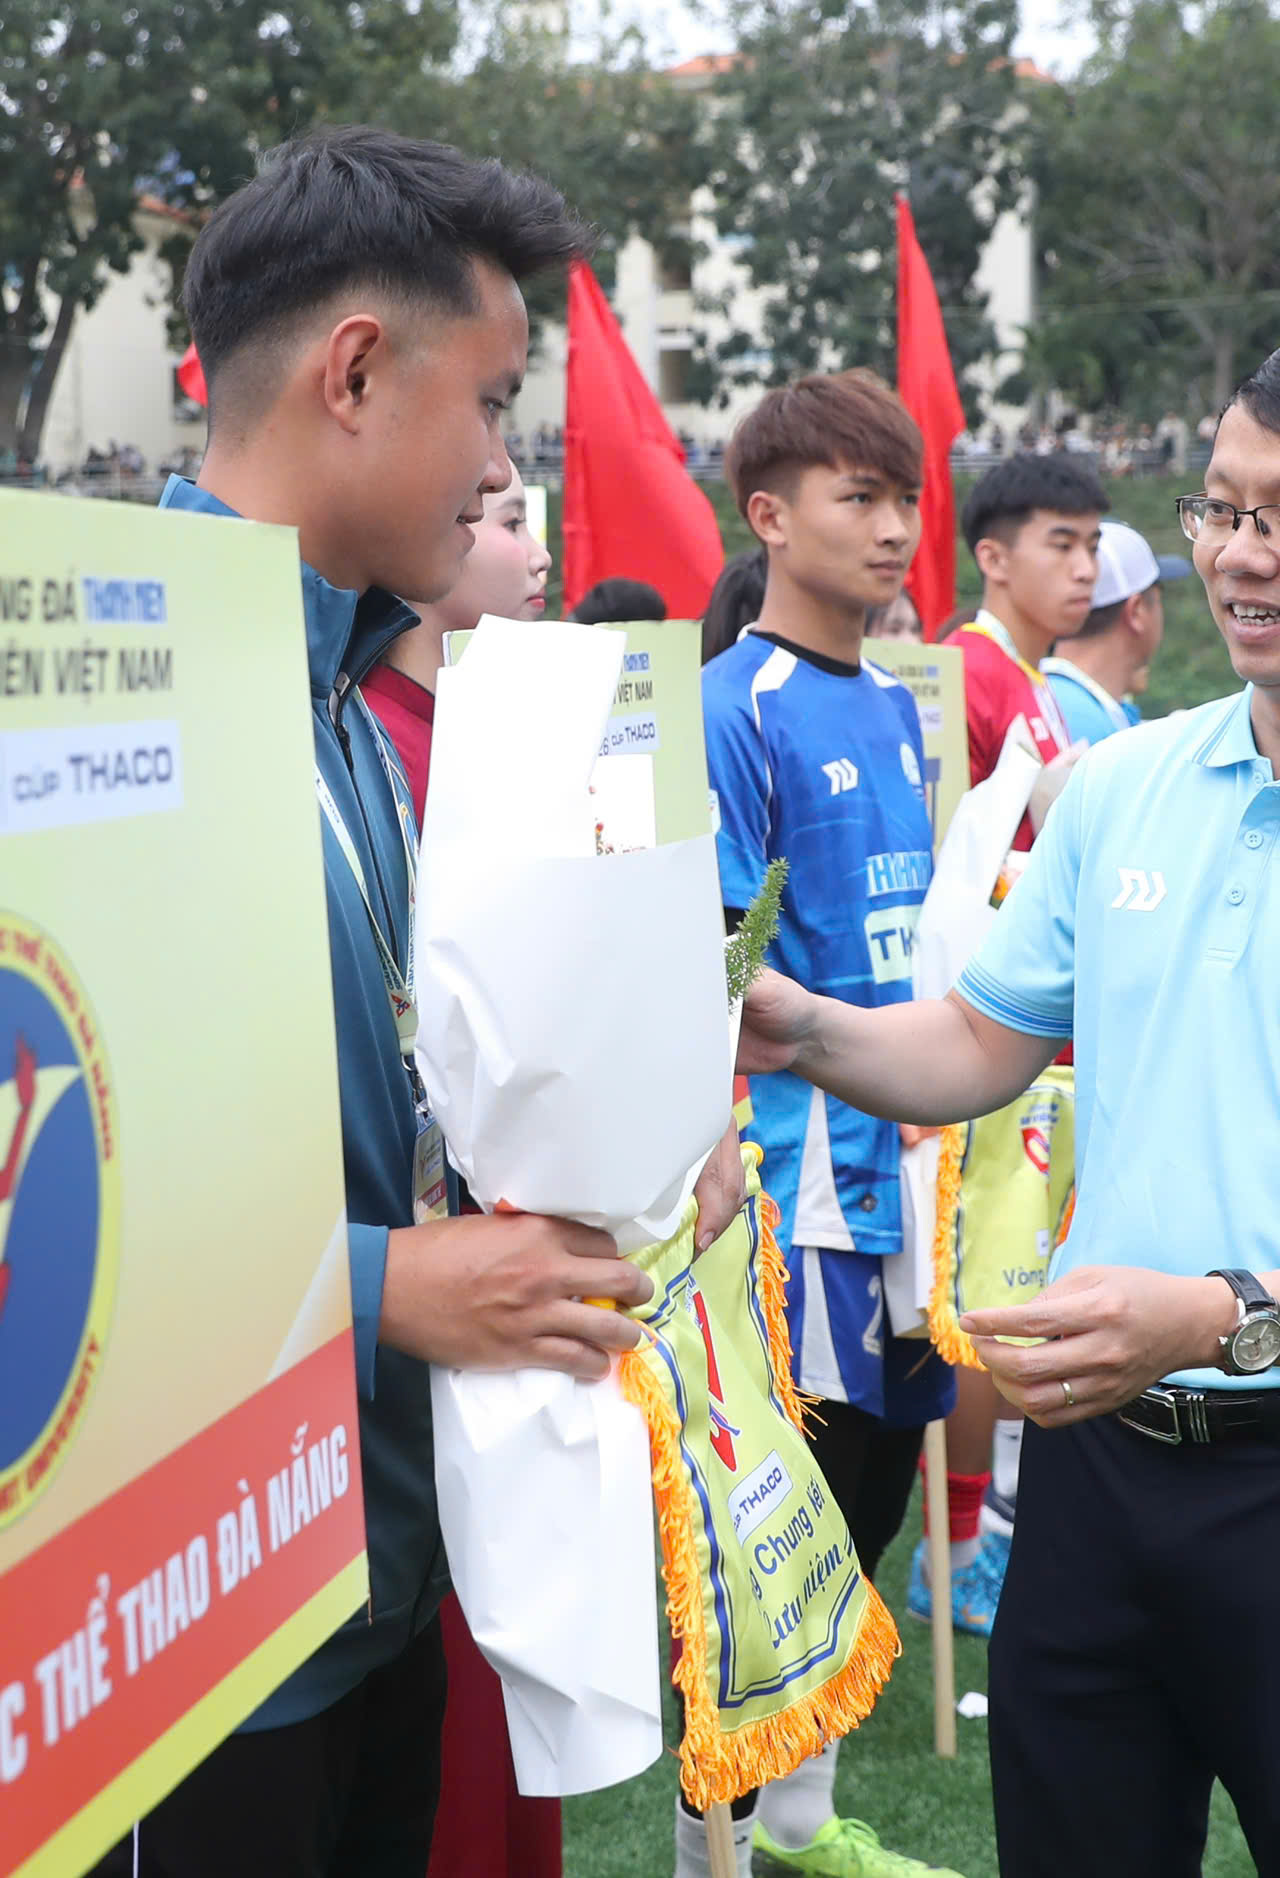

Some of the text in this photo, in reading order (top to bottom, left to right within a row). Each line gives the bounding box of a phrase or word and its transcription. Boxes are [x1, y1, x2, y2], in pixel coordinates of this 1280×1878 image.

[54, 636, 108, 704] VIỆT
[118, 648, 173, 692] NAM
[635, 680, 652, 700] NAM
[625, 722, 655, 744] THACO
[68, 745, 173, 795] THACO
[1003, 1267, 1045, 1288] Vòng
[739, 1466, 782, 1516] THACO
[754, 1504, 814, 1575] Chung
[34, 1572, 112, 1747] THỂ
[118, 1534, 211, 1677] THAO
[216, 1478, 262, 1597] ĐÀ
[267, 1421, 350, 1553] NẴNG
[803, 1543, 844, 1605] niệm
